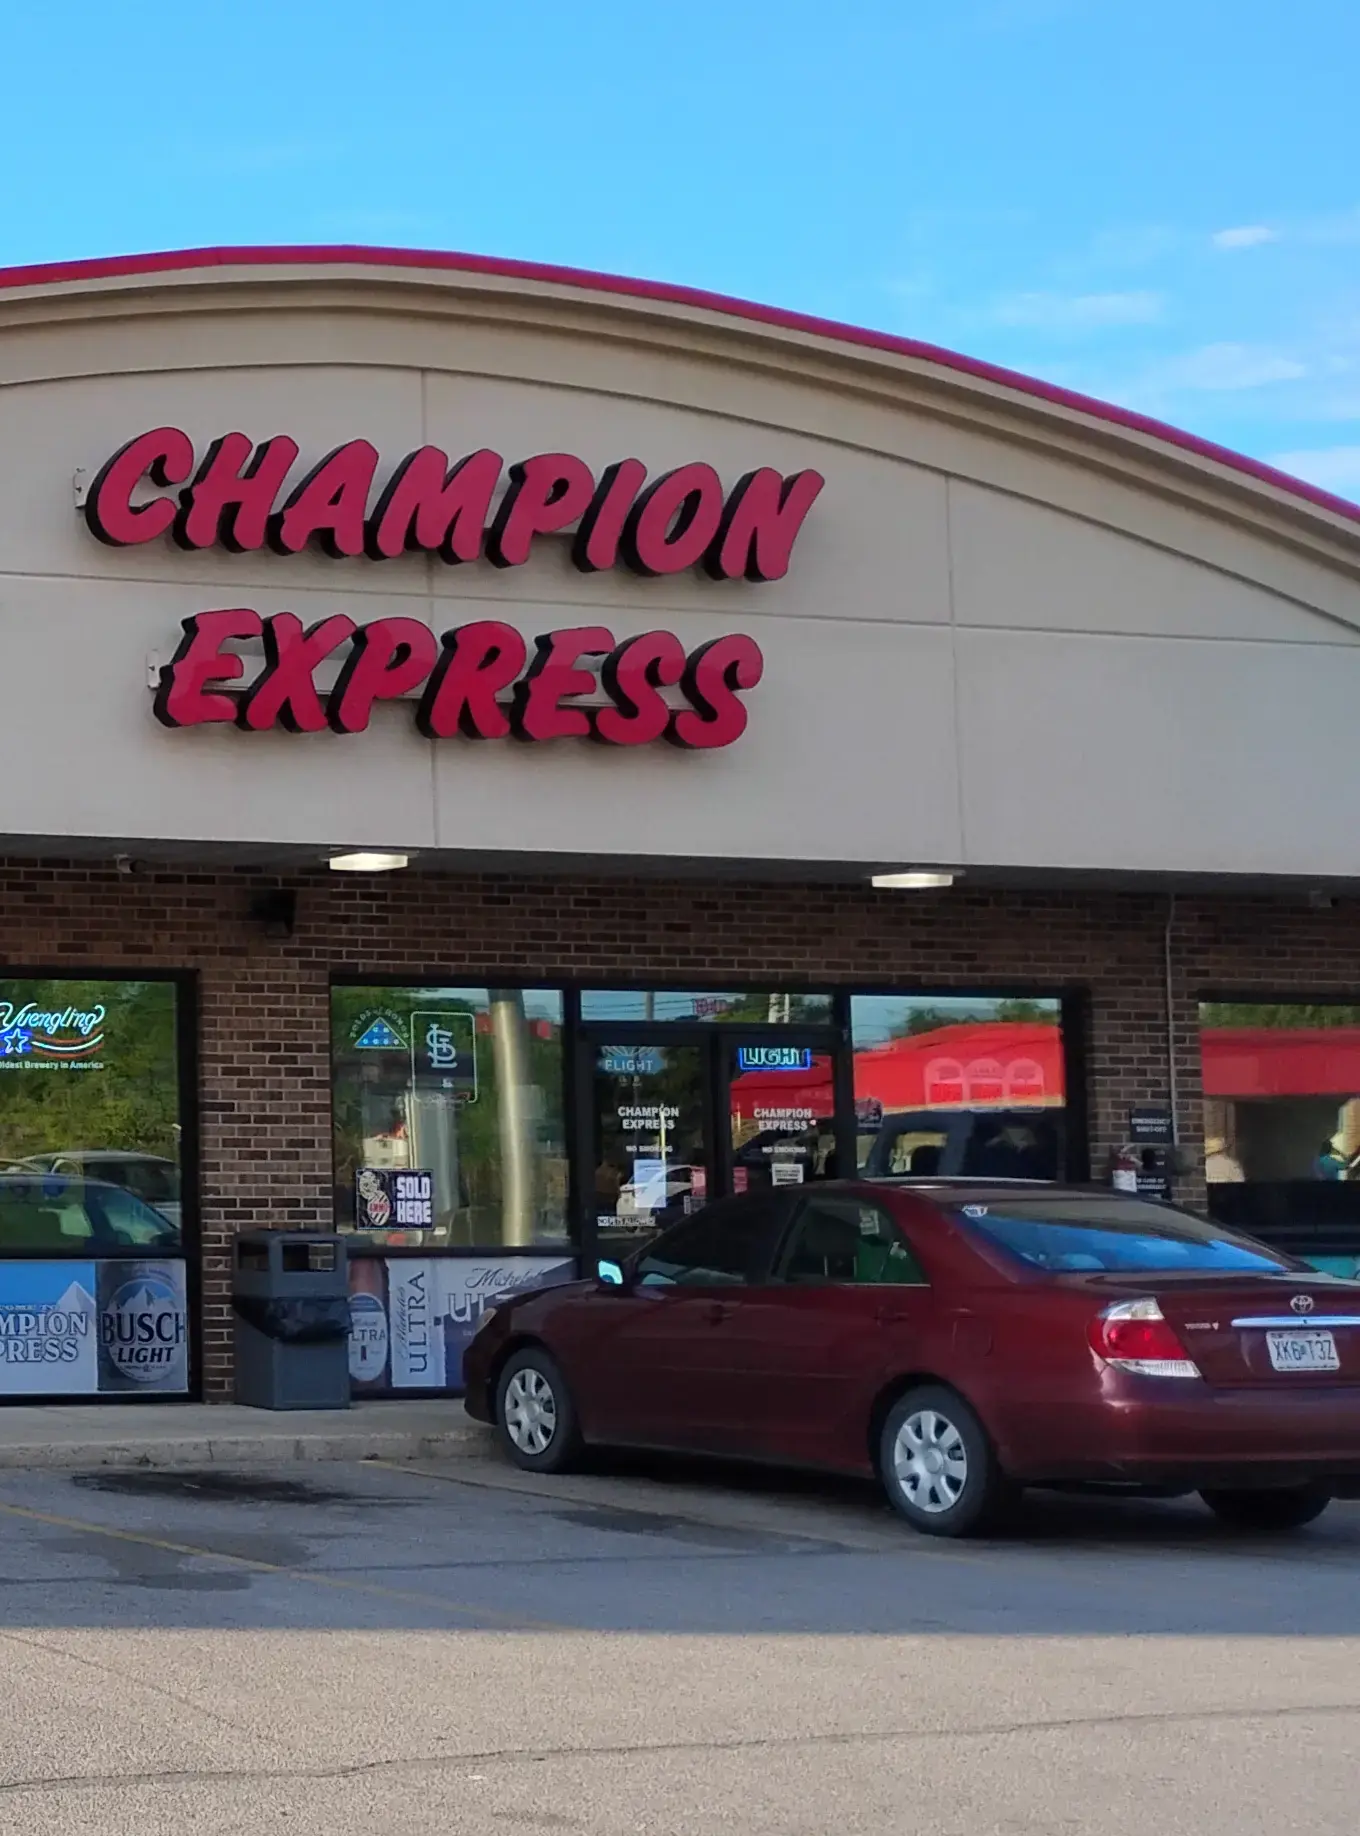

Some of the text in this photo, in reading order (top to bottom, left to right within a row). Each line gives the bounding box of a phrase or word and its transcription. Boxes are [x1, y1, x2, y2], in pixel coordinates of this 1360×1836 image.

[85, 426, 825, 582] CHAMPION
[153, 608, 763, 749] EXPRESS
[25, 1060, 59, 1070] Brewery
[70, 1061, 104, 1069] America
[617, 1106, 679, 1117] CHAMPION
[753, 1108, 812, 1118] CHAMPION
[759, 1120, 808, 1130] EXPRESS
[396, 1176, 431, 1199] SOLD
[396, 1200, 432, 1223] HERE
[101, 1312, 186, 1346] BUSCH
[407, 1271, 428, 1374] ULTRA
[351, 1327, 387, 1342] LTRA
[118, 1347, 175, 1363] LIGHT
